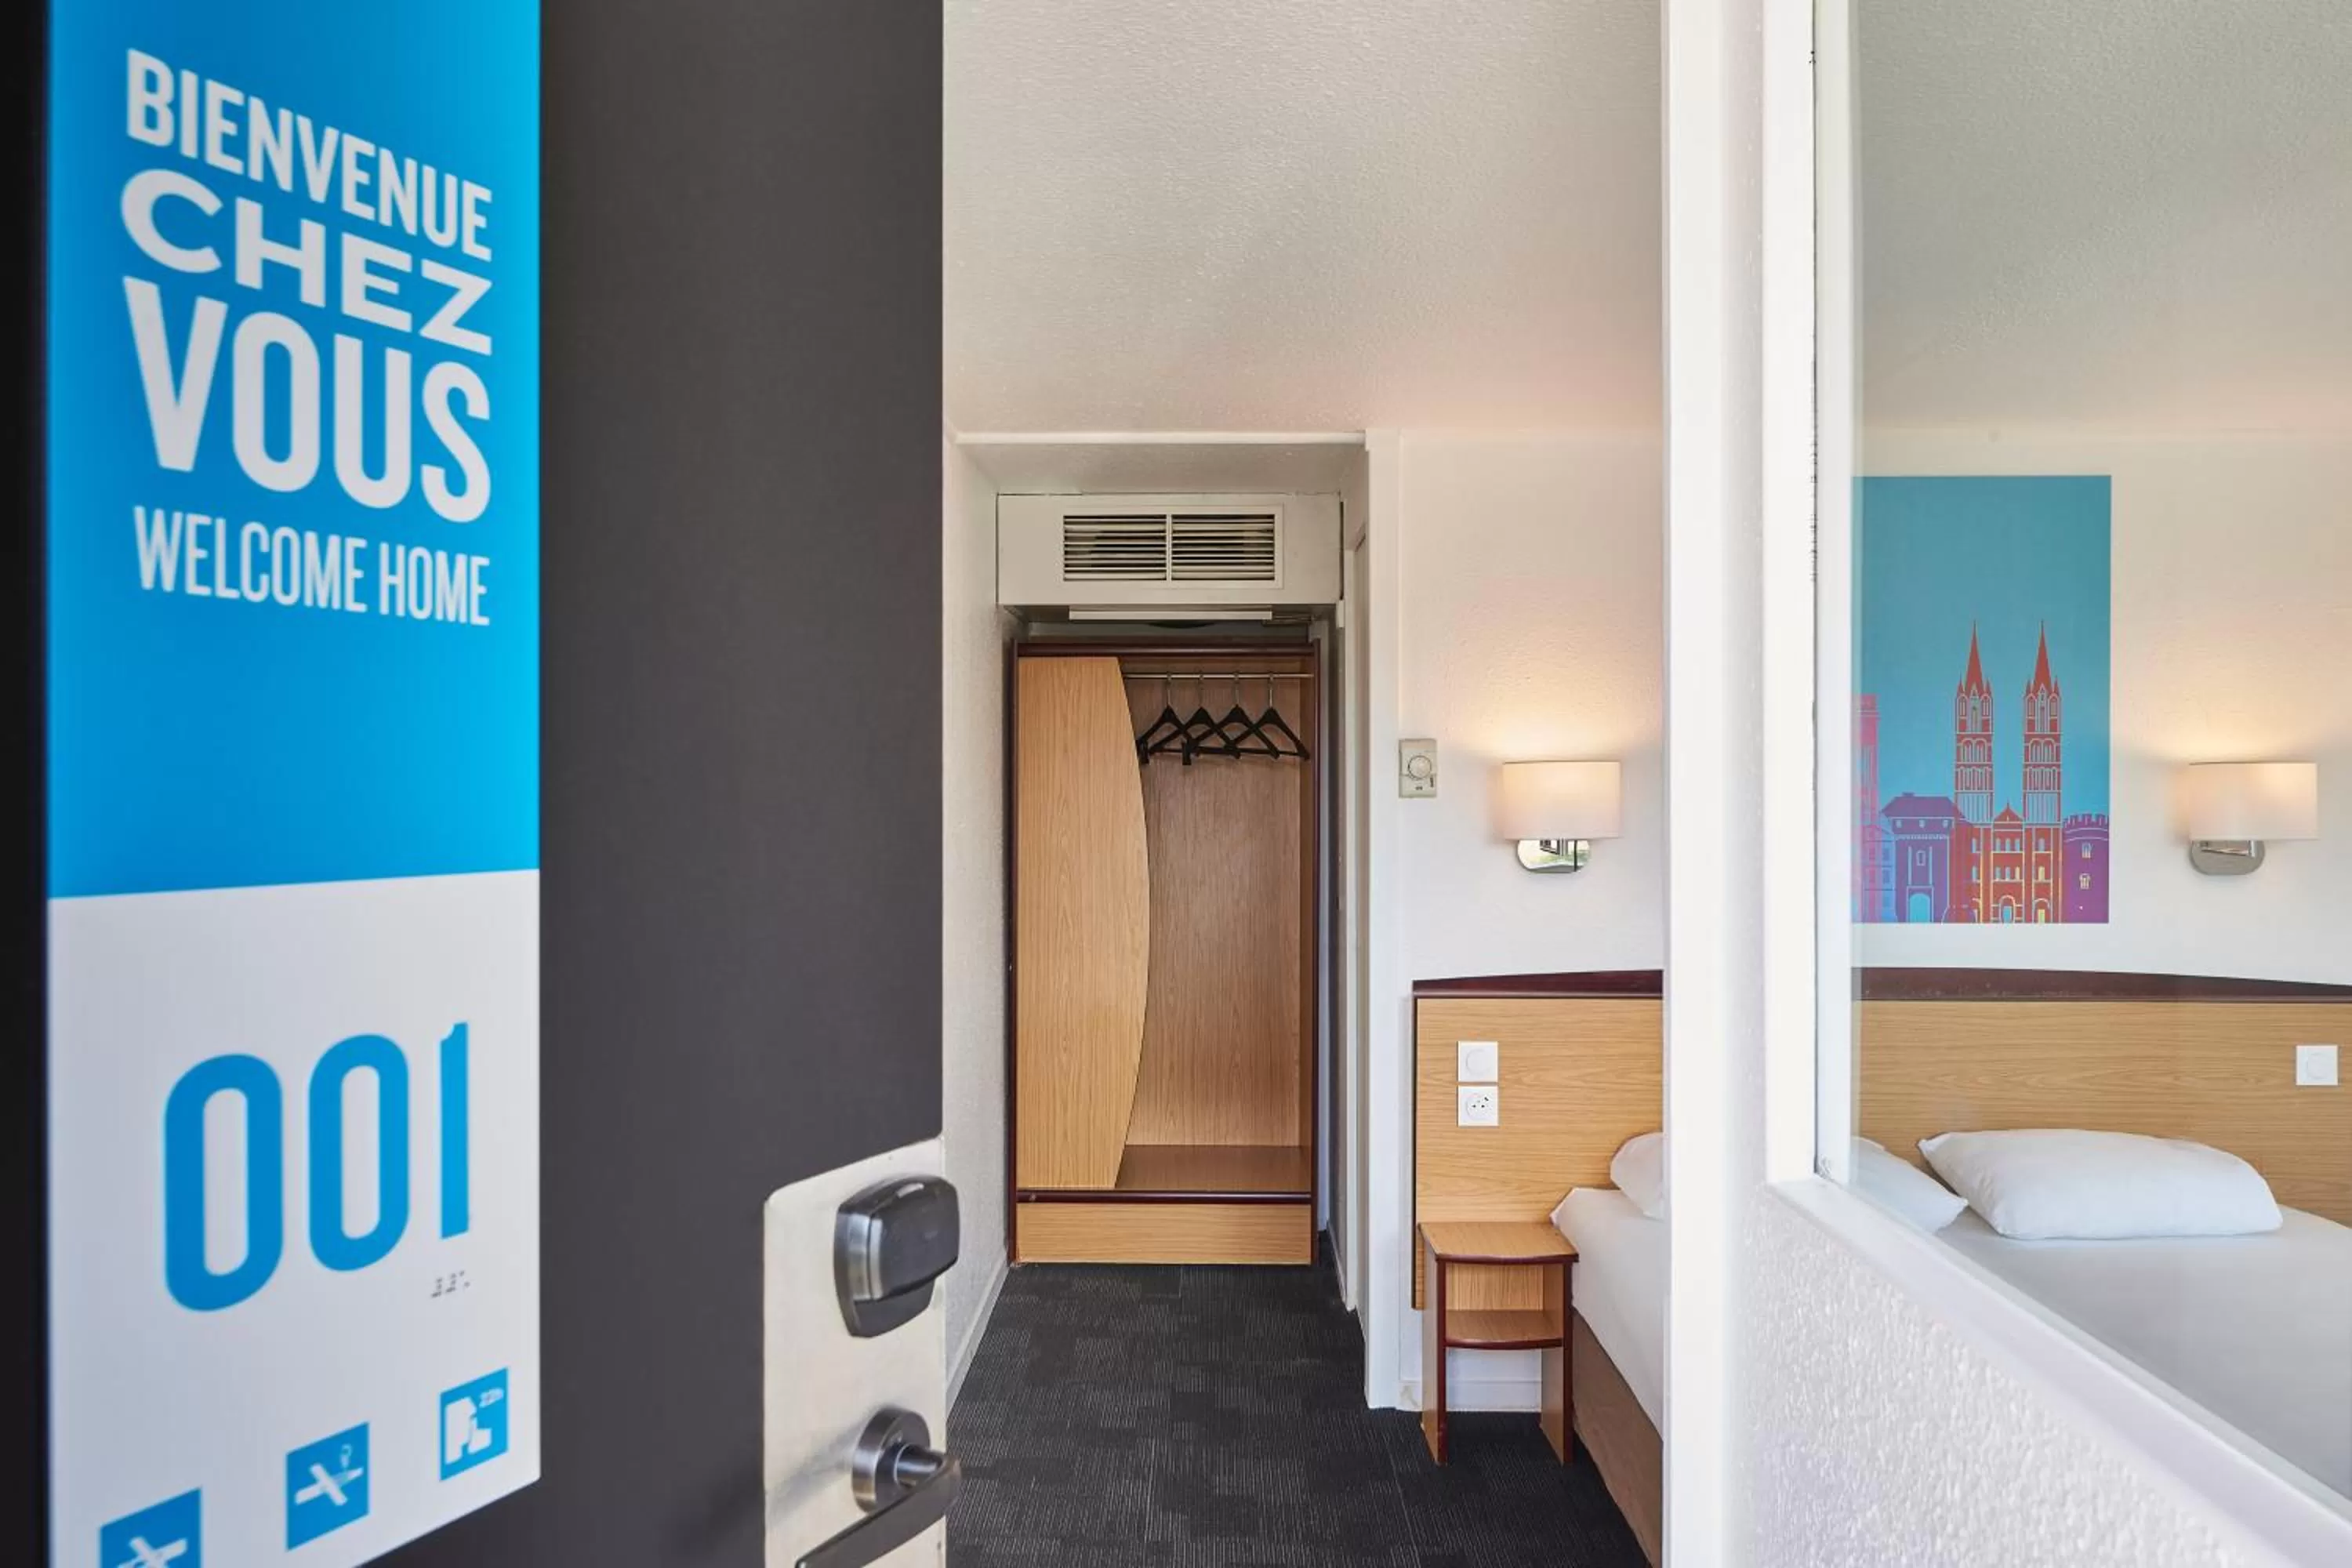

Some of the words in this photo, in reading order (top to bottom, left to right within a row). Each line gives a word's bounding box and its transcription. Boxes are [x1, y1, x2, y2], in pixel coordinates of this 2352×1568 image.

[121, 168, 492, 355] CHEZ
[127, 49, 492, 262] BIENVENUE
[122, 275, 492, 523] VOUS
[133, 505, 367, 612] WELCOME
[379, 543, 490, 626] HOME
[165, 1022, 469, 1312] 001
